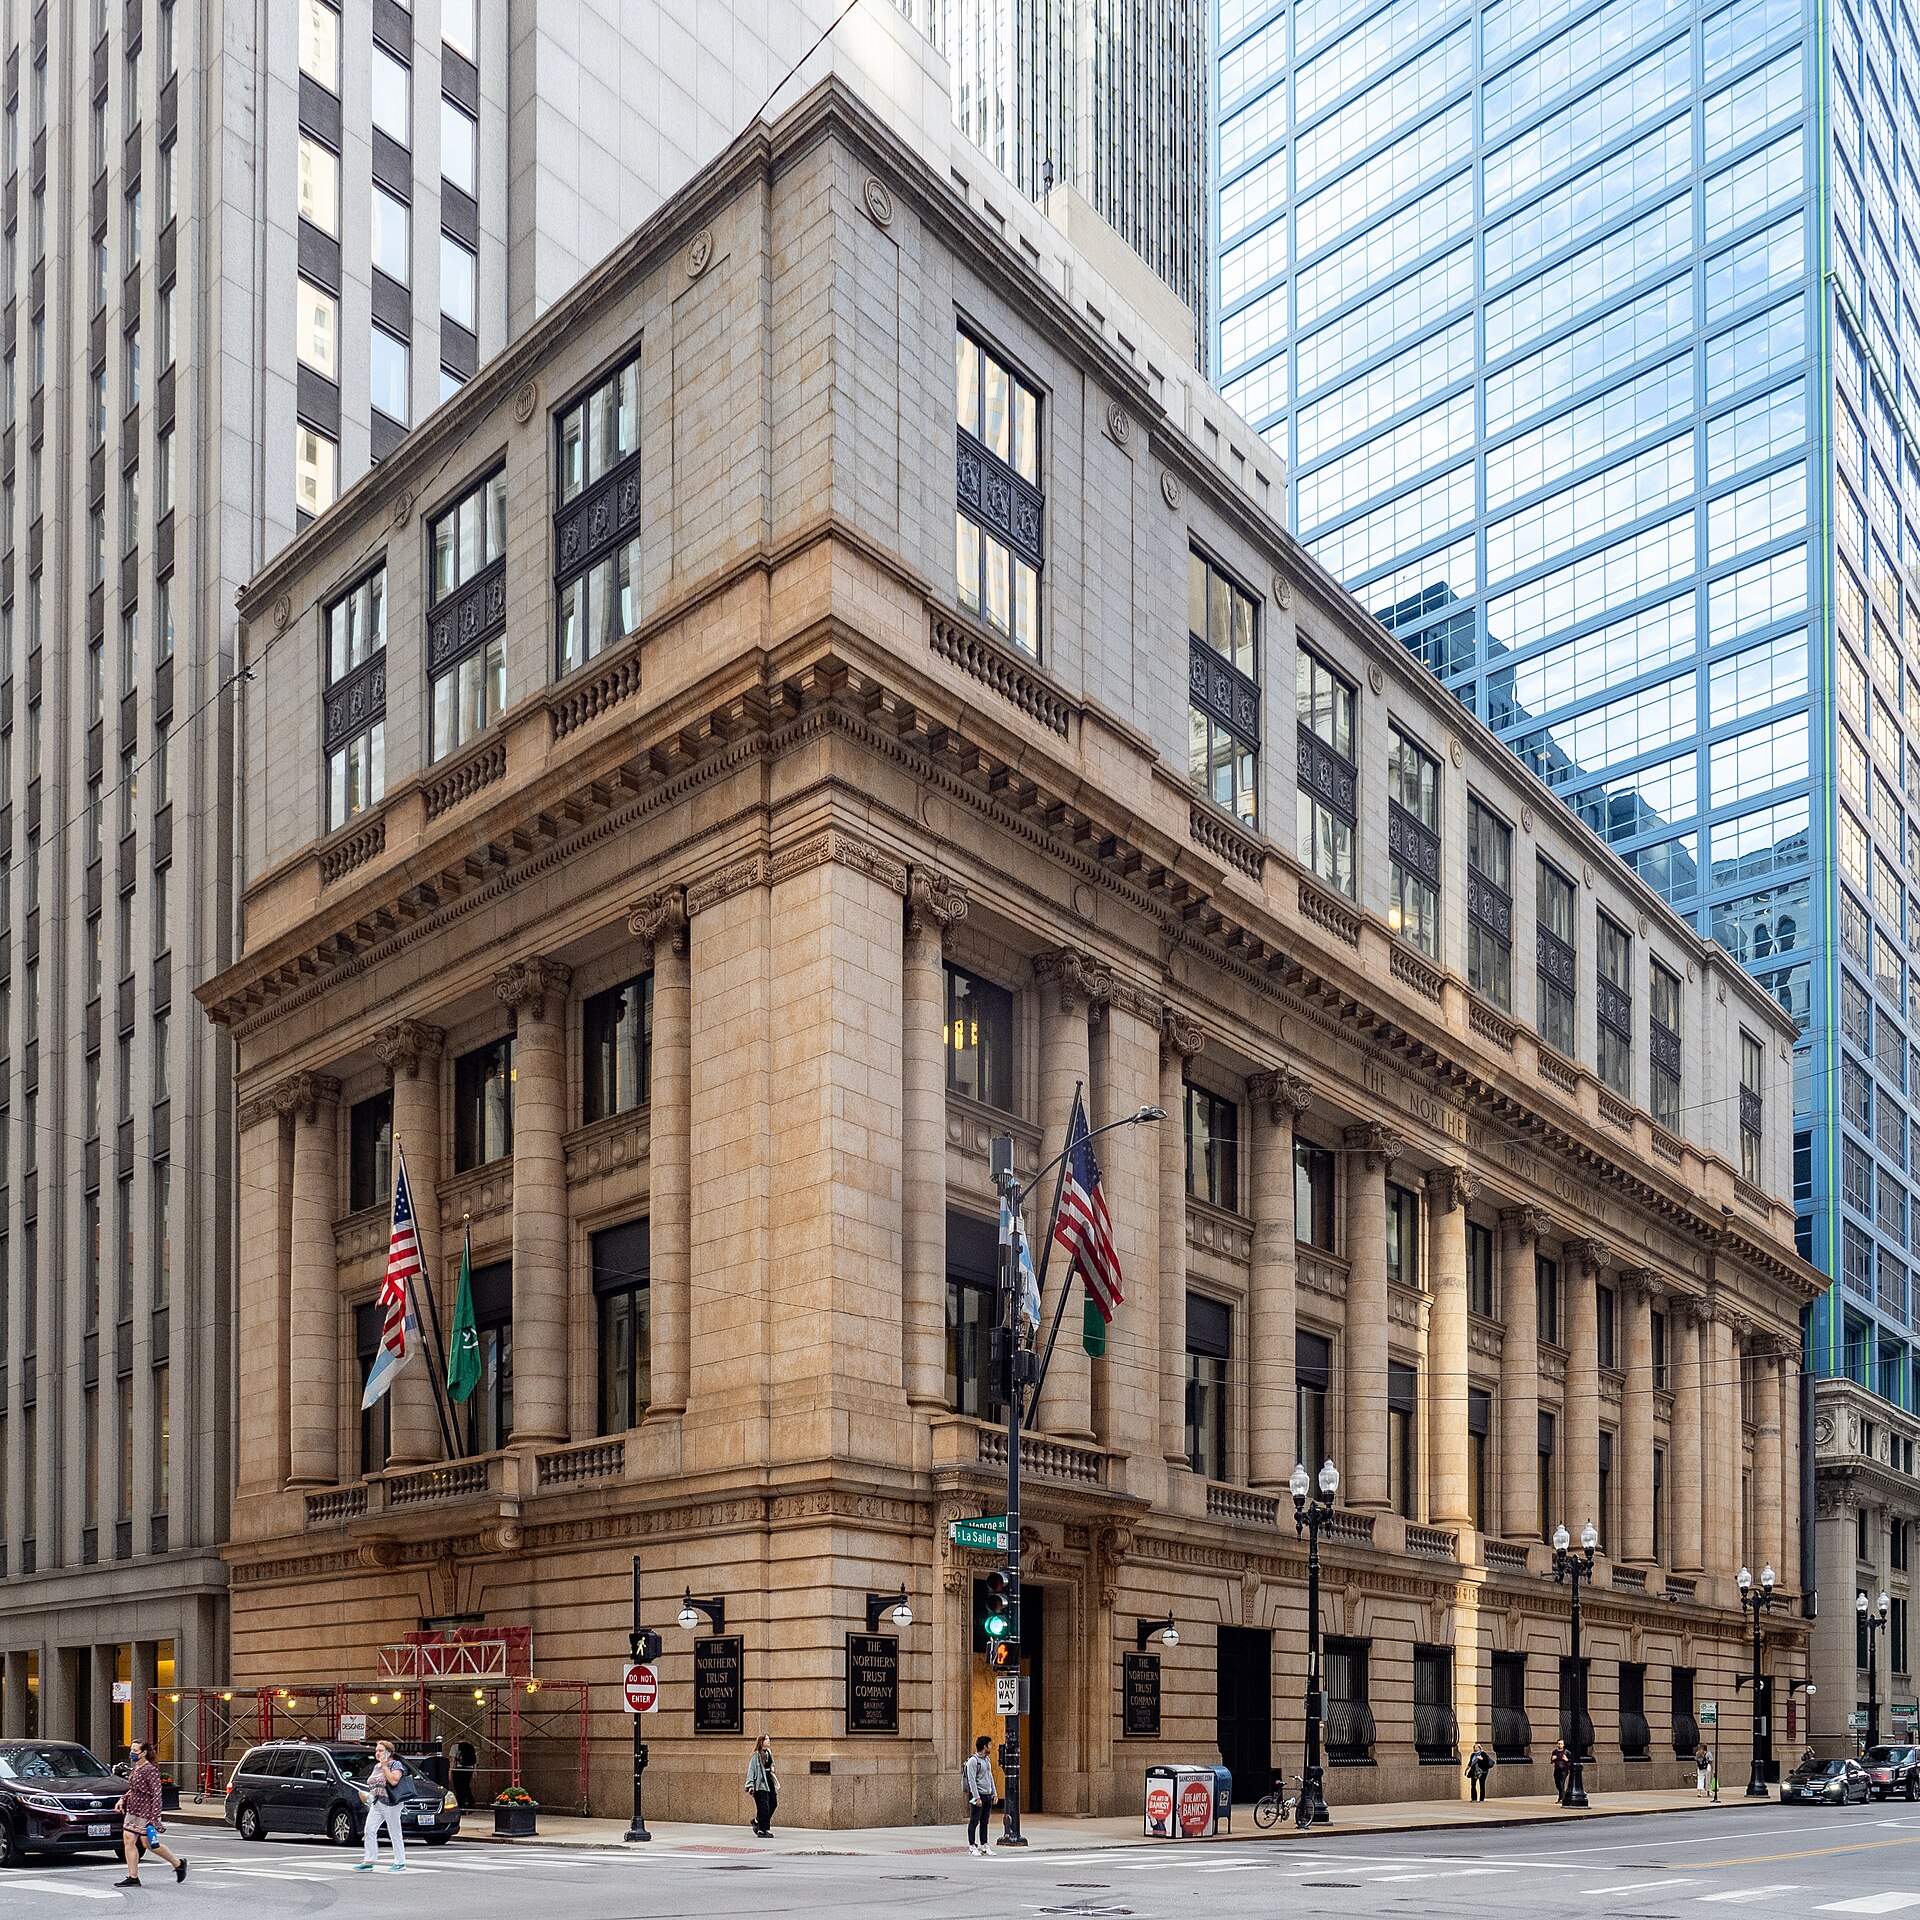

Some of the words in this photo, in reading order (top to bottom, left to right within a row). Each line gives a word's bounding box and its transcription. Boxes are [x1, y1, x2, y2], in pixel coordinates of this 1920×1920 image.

[1363, 1066, 1387, 1096] THE
[1410, 1092, 1482, 1149] NORTHERN
[1554, 1177, 1606, 1216] COMPANY
[962, 1530, 971, 1542] La
[972, 1531, 991, 1545] Salle
[711, 1643, 724, 1654] THE
[867, 1640, 882, 1652] THE
[697, 1657, 737, 1669] NORTHERN
[852, 1655, 896, 1668] NORTHERN
[1138, 1658, 1150, 1668] THE
[628, 1674, 638, 1683] DO
[640, 1675, 652, 1683] NOT
[706, 1672, 728, 1683] TRUST
[862, 1670, 887, 1683] TRUST
[1128, 1670, 1159, 1681] NORTHERN
[998, 1680, 1015, 1690] ONE
[1135, 1683, 1152, 1694] TRUST
[700, 1686, 735, 1699] COMPANY
[855, 1685, 893, 1698] COMPANY
[998, 1690, 1015, 1700] WAY
[631, 1694, 651, 1703] ENTER
[1130, 1695, 1157, 1706] COMPANY
[342, 1722, 365, 1730] DESIGNED
[1184, 1793, 1193, 1803] THE
[1193, 1792, 1201, 1802] ART
[1201, 1792, 1208, 1802] OF
[1149, 1800, 1170, 1809] BANKSY
[1182, 1802, 1208, 1816] BANKSY
